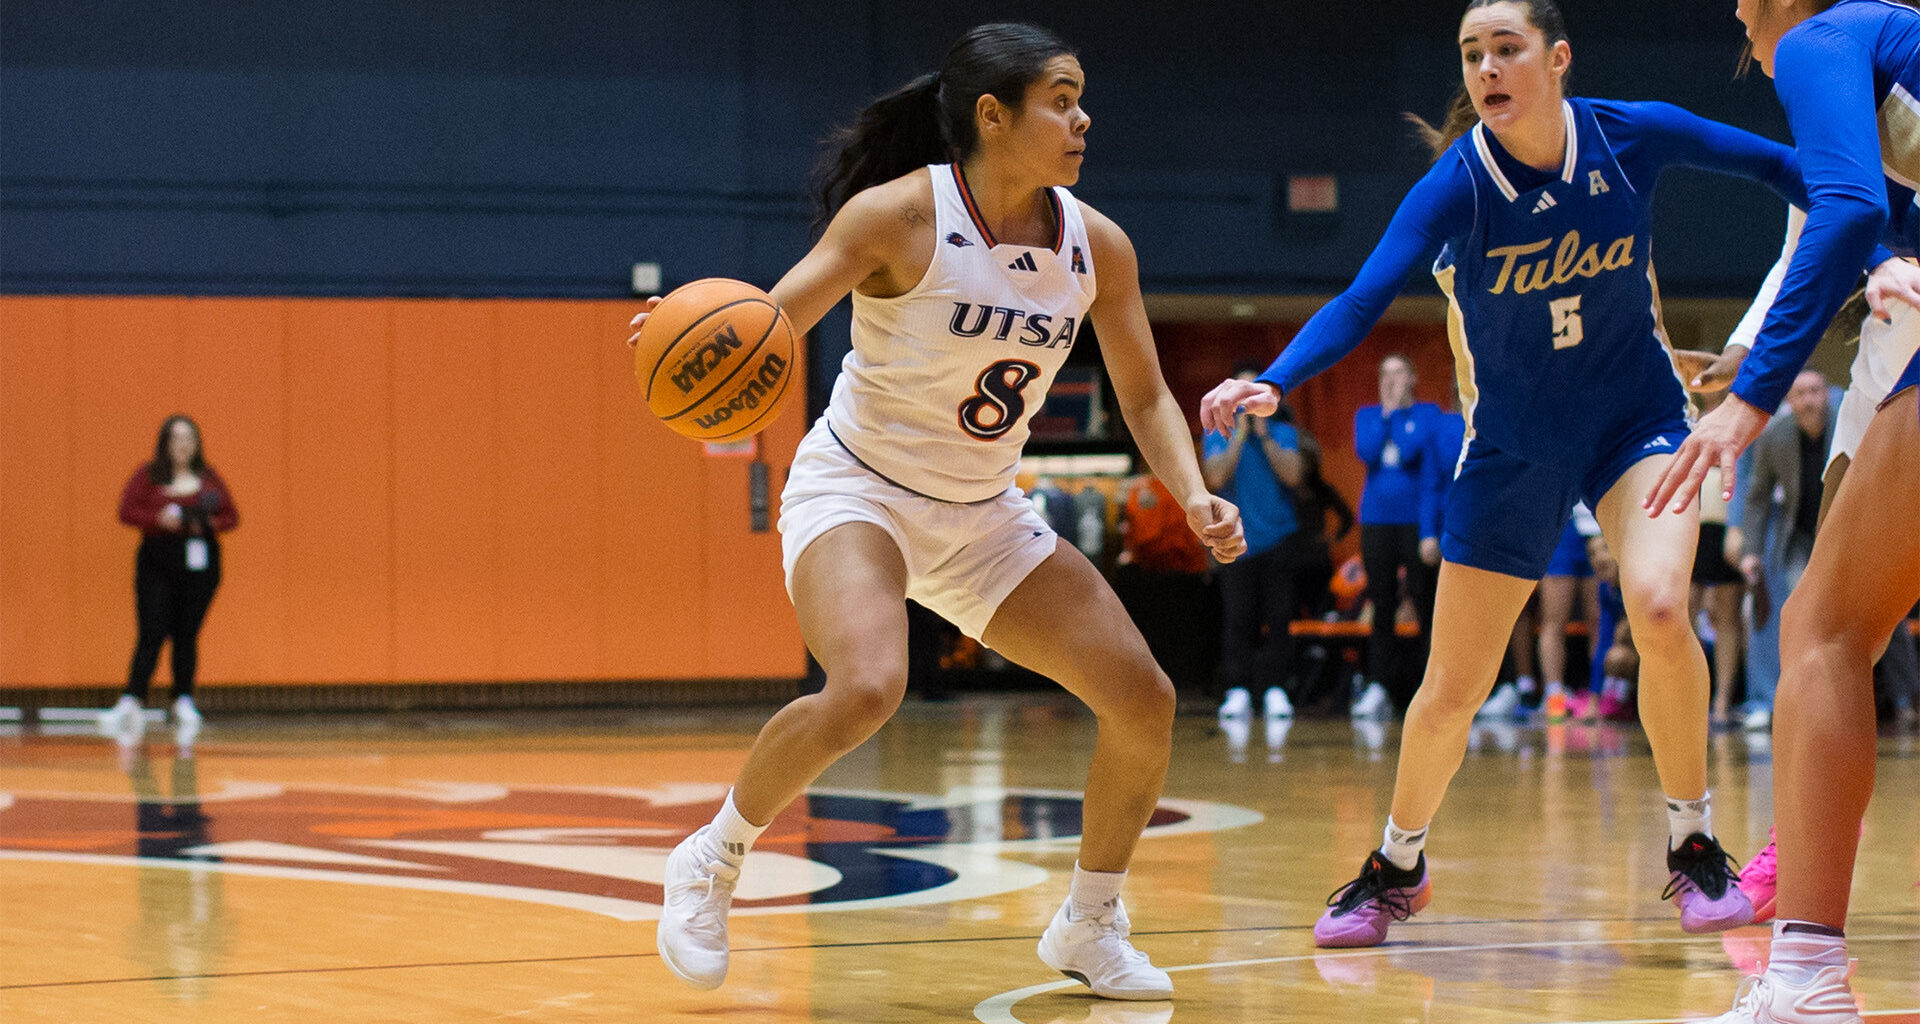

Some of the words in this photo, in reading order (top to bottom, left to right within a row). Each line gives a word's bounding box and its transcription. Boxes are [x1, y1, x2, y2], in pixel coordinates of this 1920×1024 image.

[1486, 229, 1634, 294] Tulsa
[949, 301, 1076, 349] UTSA
[1549, 294, 1584, 350] 5
[671, 323, 743, 395] NCAA
[693, 352, 787, 429] Wilson
[957, 358, 1042, 442] 8
